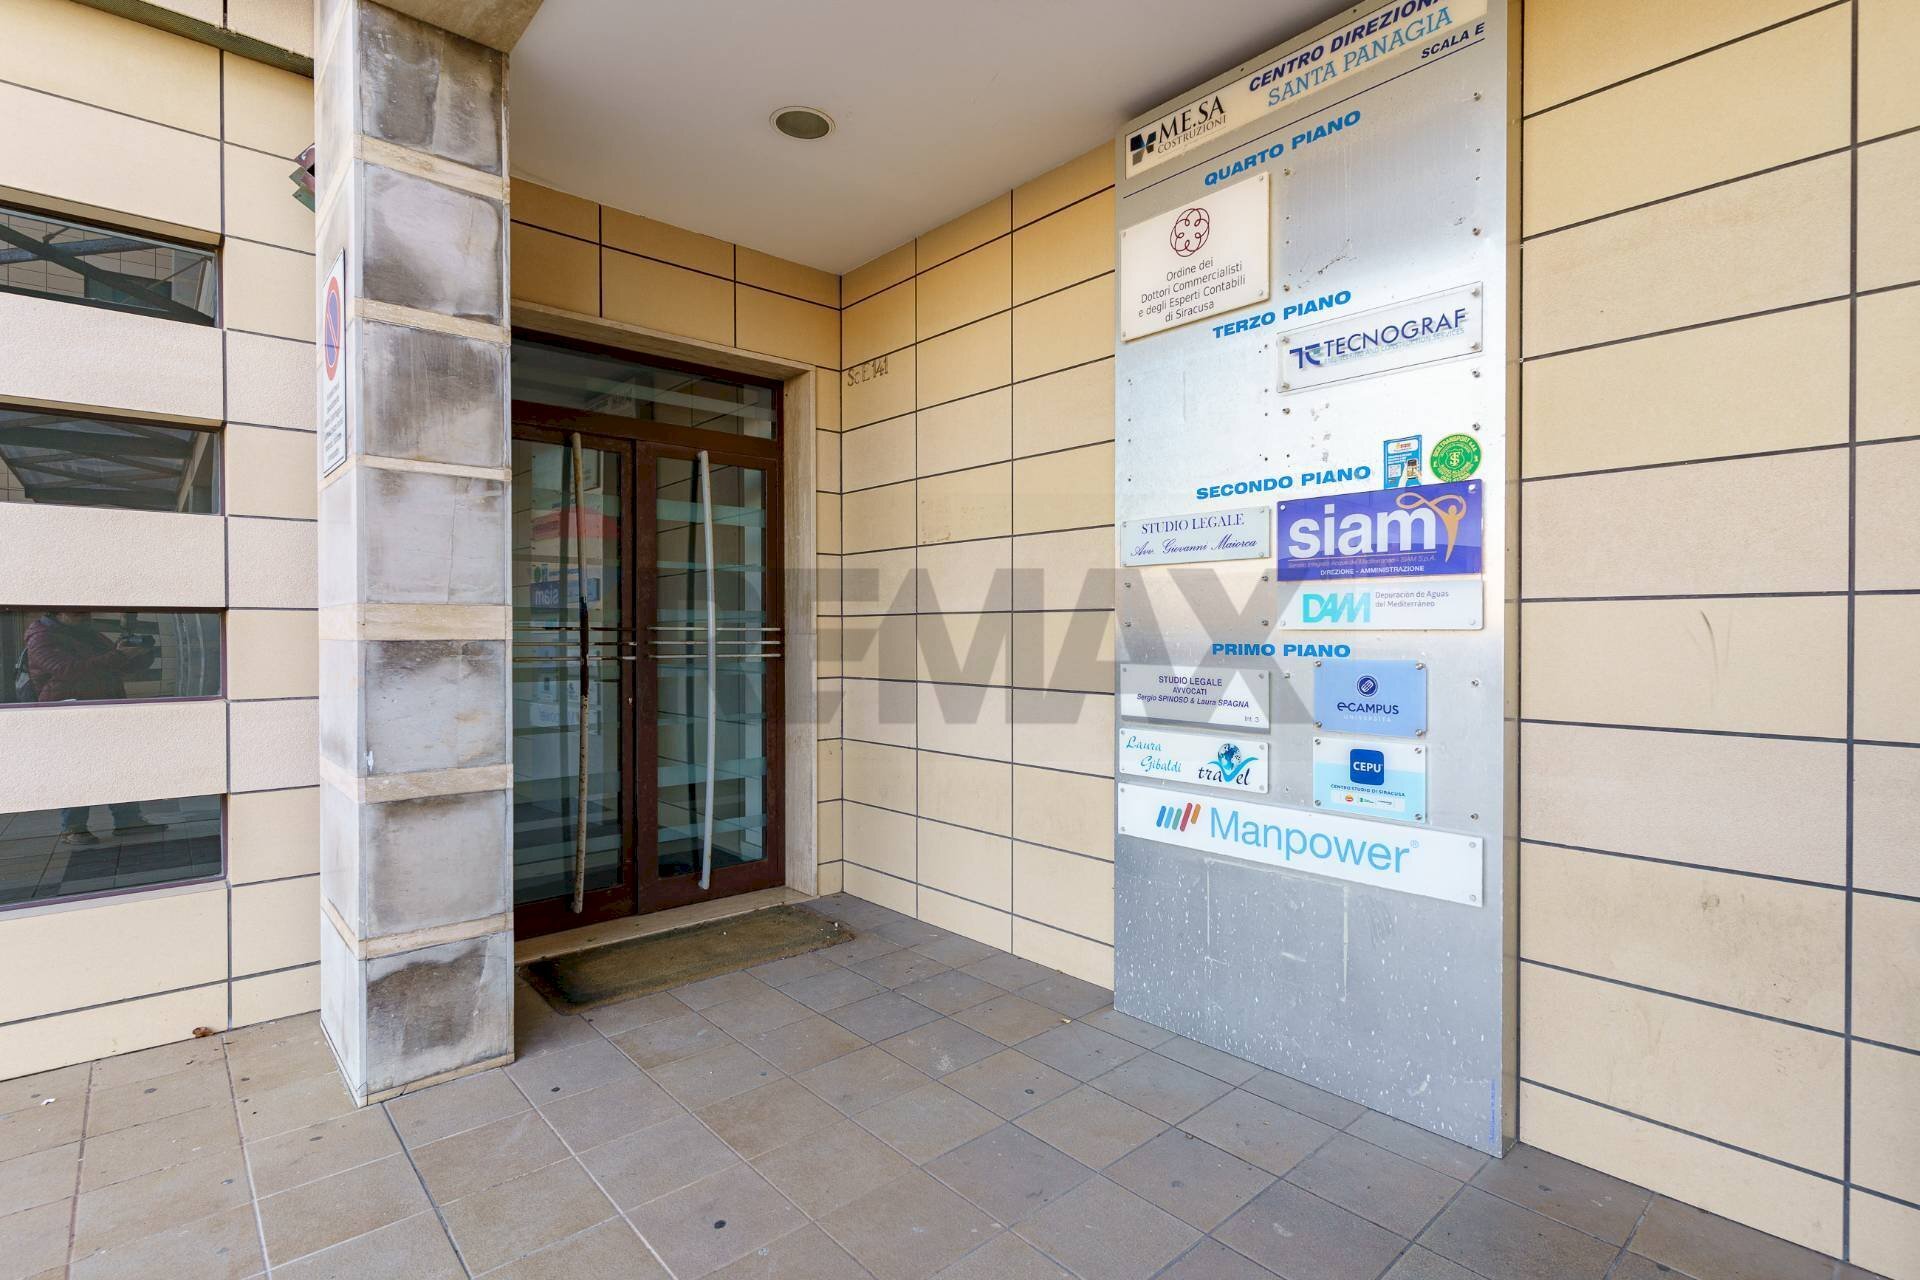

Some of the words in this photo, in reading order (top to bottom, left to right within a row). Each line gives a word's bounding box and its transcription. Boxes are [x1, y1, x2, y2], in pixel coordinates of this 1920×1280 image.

[1249, 46, 1325, 91] CENTRO
[1330, 0, 1441, 54] DIREZION
[1421, 30, 1470, 59] SCALA
[1474, 22, 1486, 36] E
[1268, 61, 1338, 107] SANTA
[1343, 7, 1453, 72] PANAGIA
[1159, 95, 1225, 143] ME.SA
[1157, 115, 1227, 154] COSTRUZIONI
[1204, 143, 1285, 186] QUARTO
[1291, 110, 1361, 150] PIANO
[1166, 263, 1196, 282] Ordine
[1198, 257, 1214, 271] dei
[1141, 284, 1171, 304] Dottori
[1172, 261, 1243, 293] Commercialisti
[1138, 308, 1144, 318] e
[1146, 300, 1167, 317] degli
[1169, 291, 1200, 312] Esperti
[1203, 274, 1247, 297] Contabili
[1164, 310, 1173, 323] di
[1175, 300, 1215, 321] Siracusa
[1212, 311, 1276, 339] TERZO
[1283, 290, 1352, 320] PIANO
[1323, 308, 1466, 357] TECNOGRAF
[1196, 475, 1294, 500] SECONDO
[1301, 465, 1371, 486] PIANO
[1141, 520, 1189, 535] STUDIO
[1191, 513, 1245, 530] LEGALE
[1288, 504, 1436, 559] siam
[1162, 538, 1208, 554] Giovanni
[1211, 533, 1258, 551] Maiorca
[1320, 567, 1354, 576] DIREZIONE
[1360, 565, 1425, 575] AMMINISTRAZIONE
[1375, 600, 1386, 608] del
[1426, 590, 1450, 599] Aguas
[1302, 592, 1371, 623] DAM
[1212, 643, 1276, 657] PRIMO
[1283, 644, 1351, 658] PIANO
[1158, 675, 1188, 685] STUDIO
[1189, 677, 1223, 687] LEGALE
[1172, 686, 1207, 696] AVVOCATI
[1136, 693, 1157, 702] Sergio
[1158, 695, 1188, 704] SPINOSO
[1196, 698, 1217, 706] Laura
[1218, 699, 1249, 709] SPAGNA
[1125, 735, 1162, 752] Laura
[1140, 755, 1182, 773] Gibaldi
[1353, 761, 1382, 773] CEPU
